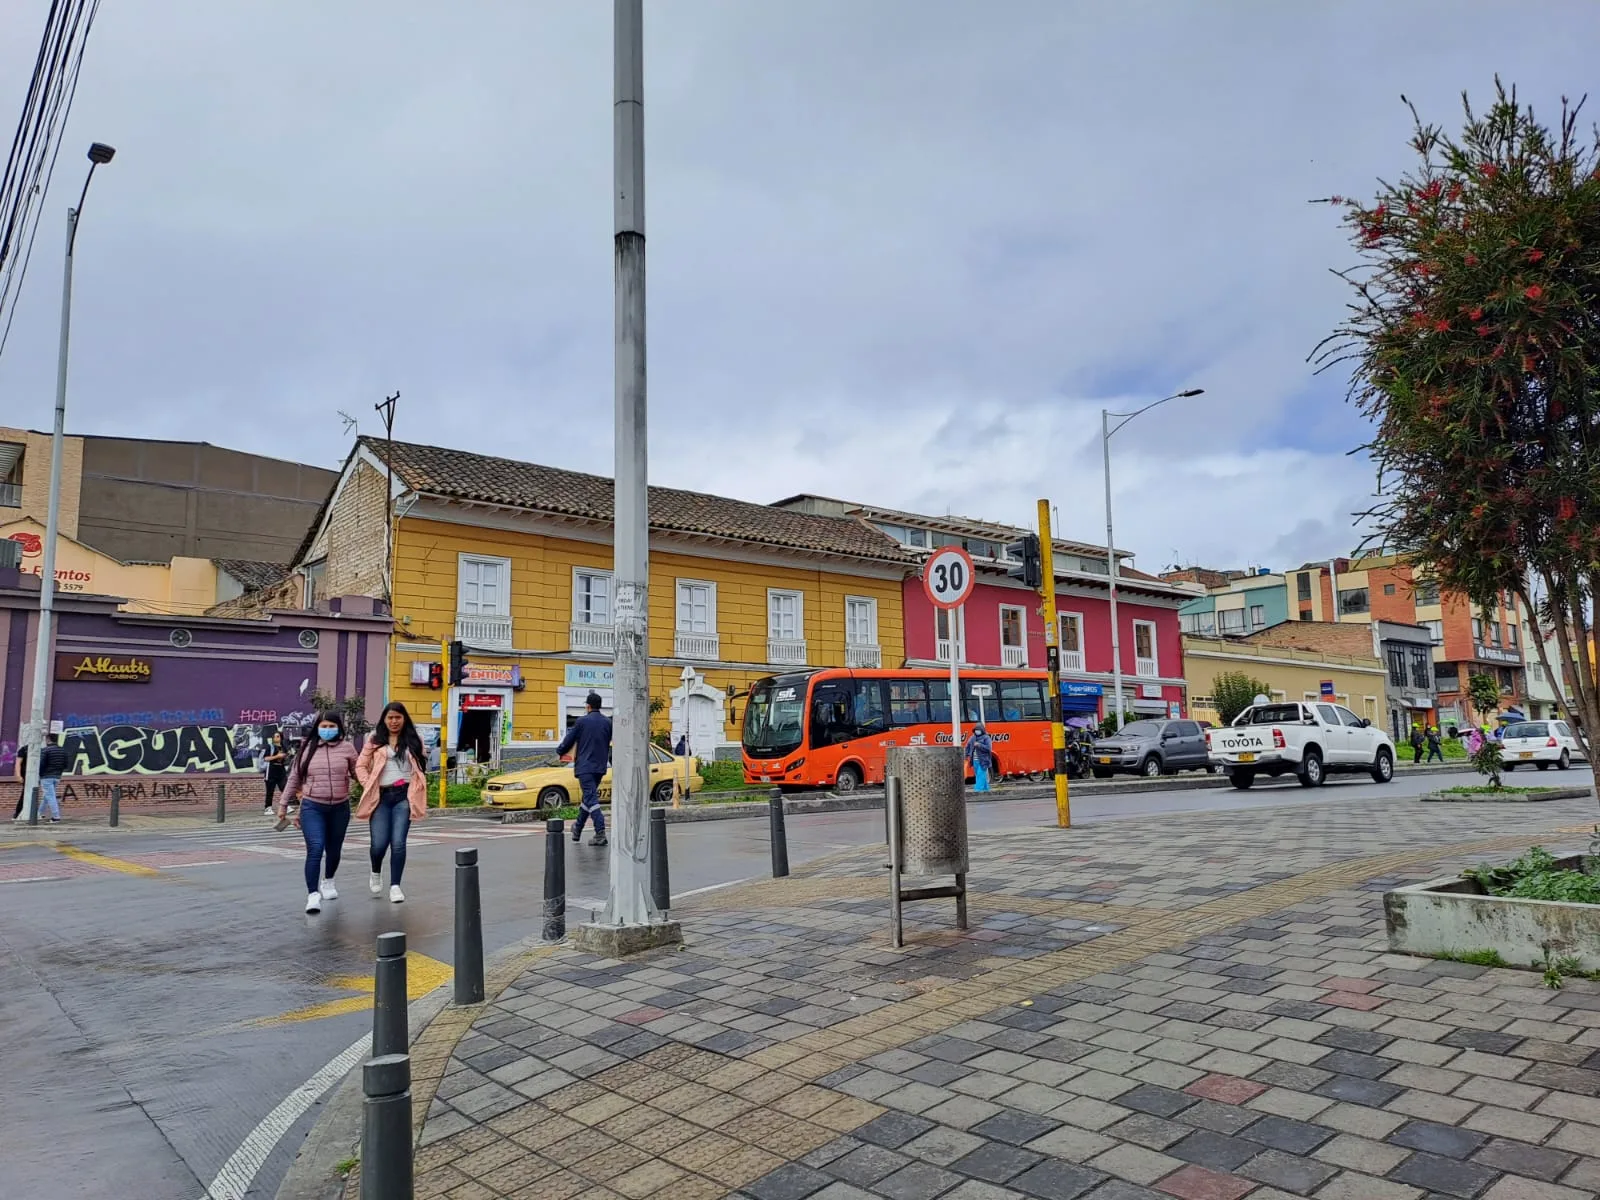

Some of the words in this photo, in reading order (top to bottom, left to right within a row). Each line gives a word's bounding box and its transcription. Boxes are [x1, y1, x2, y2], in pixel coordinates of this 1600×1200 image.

[33, 565, 91, 582] Eentos
[935, 561, 963, 593] 30
[73, 656, 150, 678] Atlantis
[1221, 738, 1264, 749] TOYOTA
[151, 782, 198, 799] LINEA
